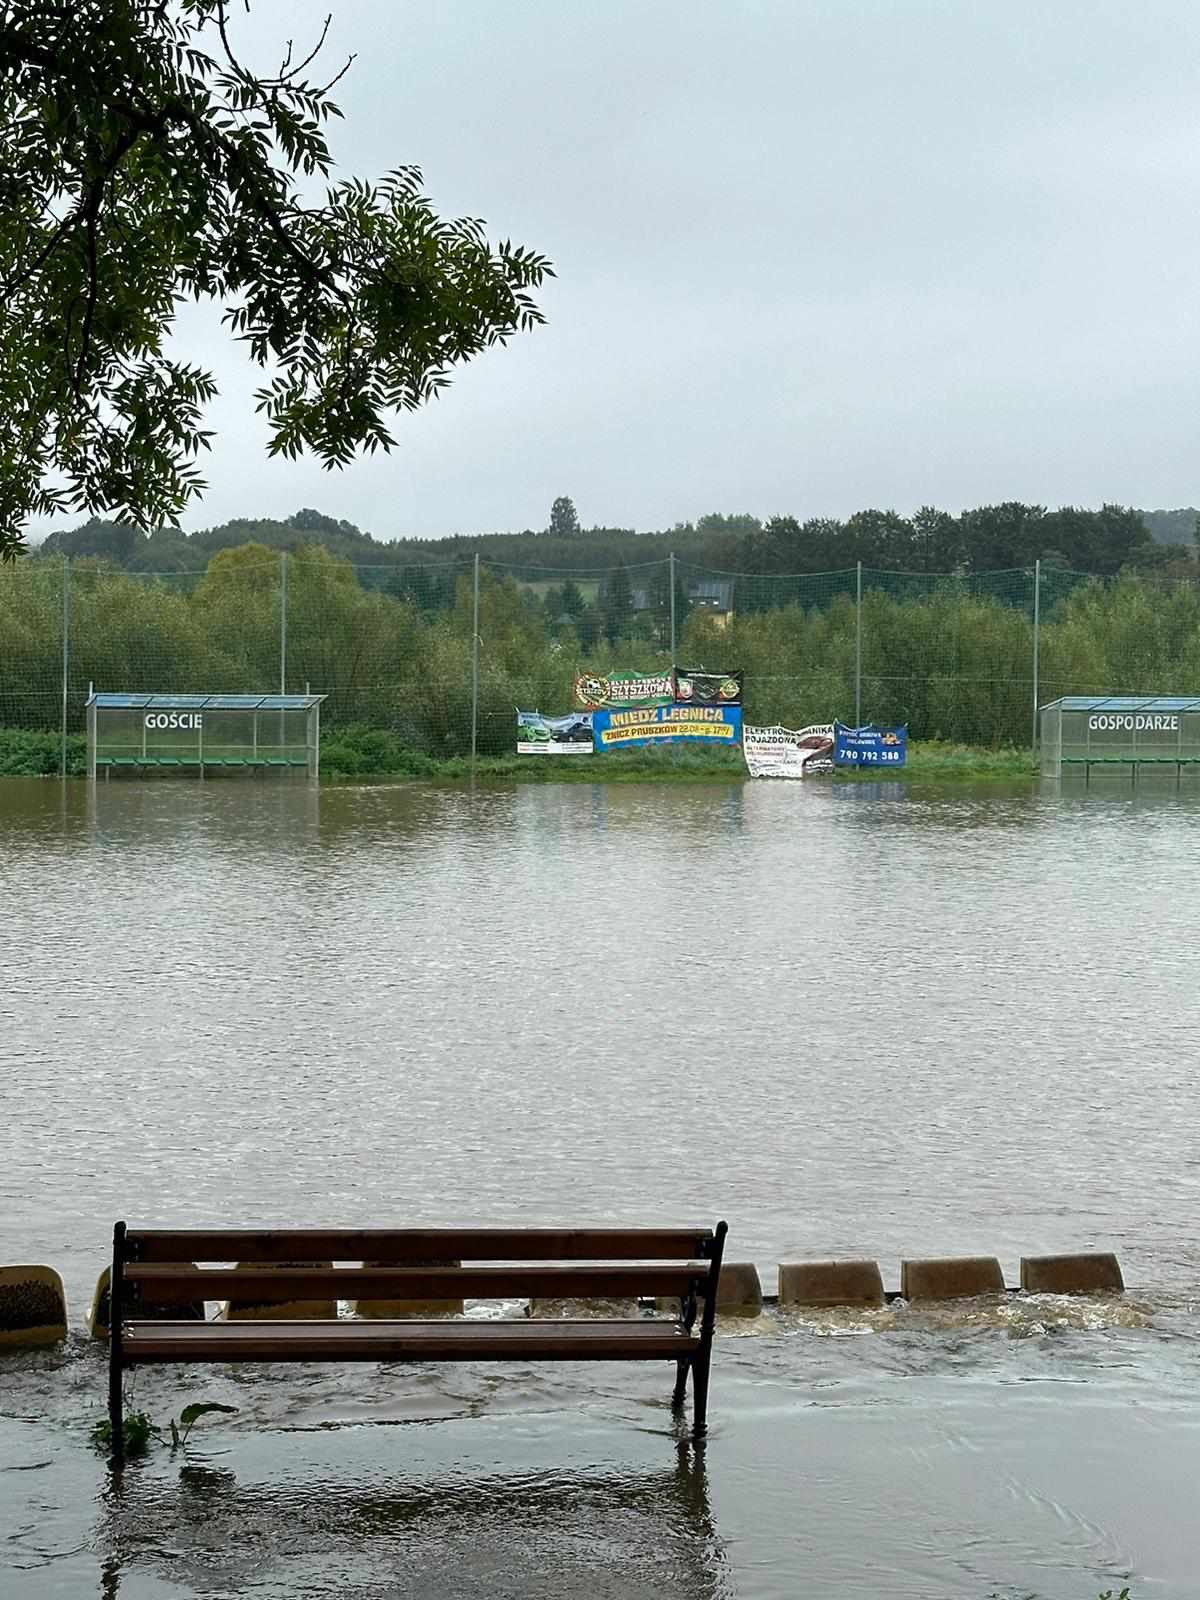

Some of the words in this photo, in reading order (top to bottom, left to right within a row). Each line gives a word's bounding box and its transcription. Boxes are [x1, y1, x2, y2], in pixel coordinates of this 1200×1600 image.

[144, 711, 203, 729] GOŚCIE
[662, 707, 724, 721] LEGNICA
[839, 749, 858, 759] 790
[862, 751, 878, 761] 792
